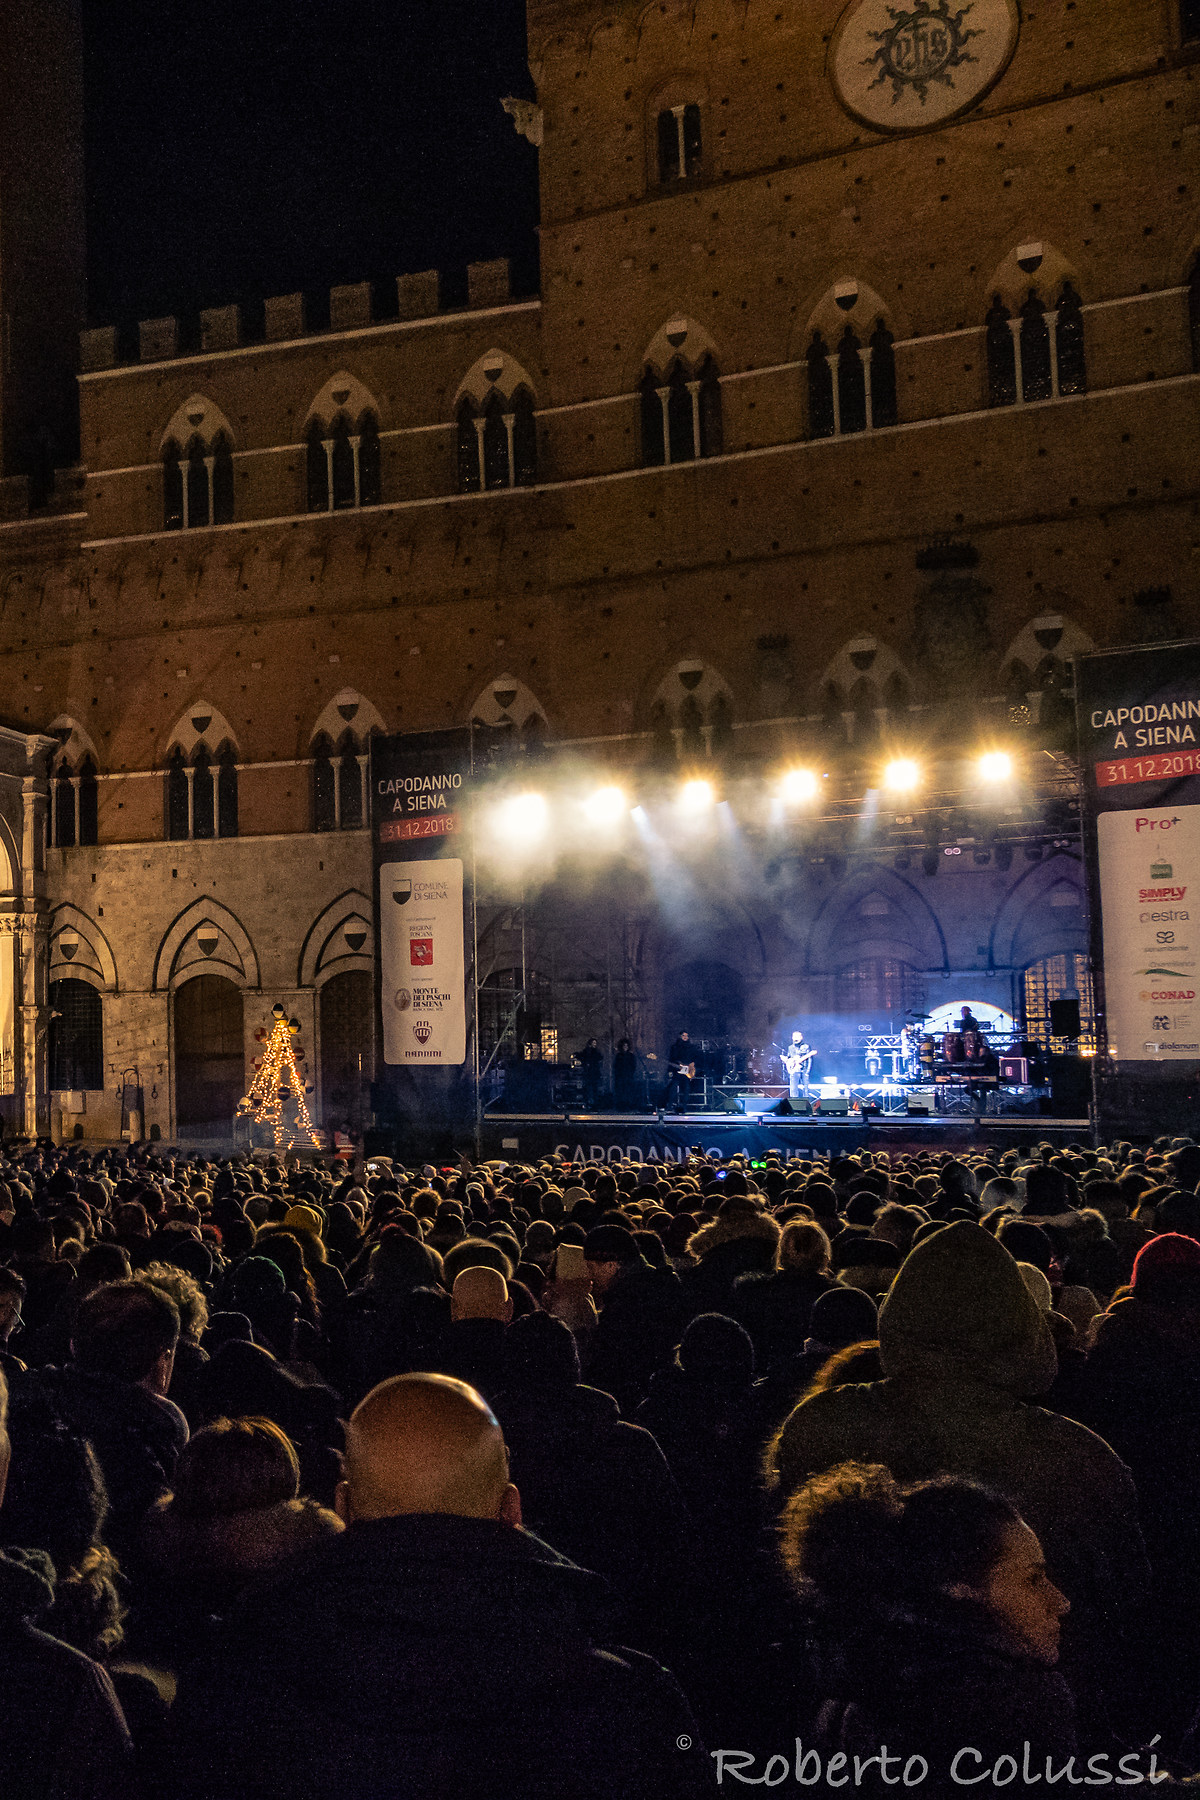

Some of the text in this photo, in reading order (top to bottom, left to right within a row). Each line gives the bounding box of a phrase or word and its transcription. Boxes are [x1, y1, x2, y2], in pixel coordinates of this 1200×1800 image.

[1091, 700, 1200, 728] CAPODANN
[1114, 725, 1196, 749] A SIENA
[378, 773, 462, 795] CAPODANNO
[392, 794, 447, 813] A SIENA
[388, 817, 454, 840] 31.12.2018
[413, 882, 448, 892] COMUNE
[414, 891, 448, 901] DI SIENA
[1151, 991, 1196, 1000] CONAD
